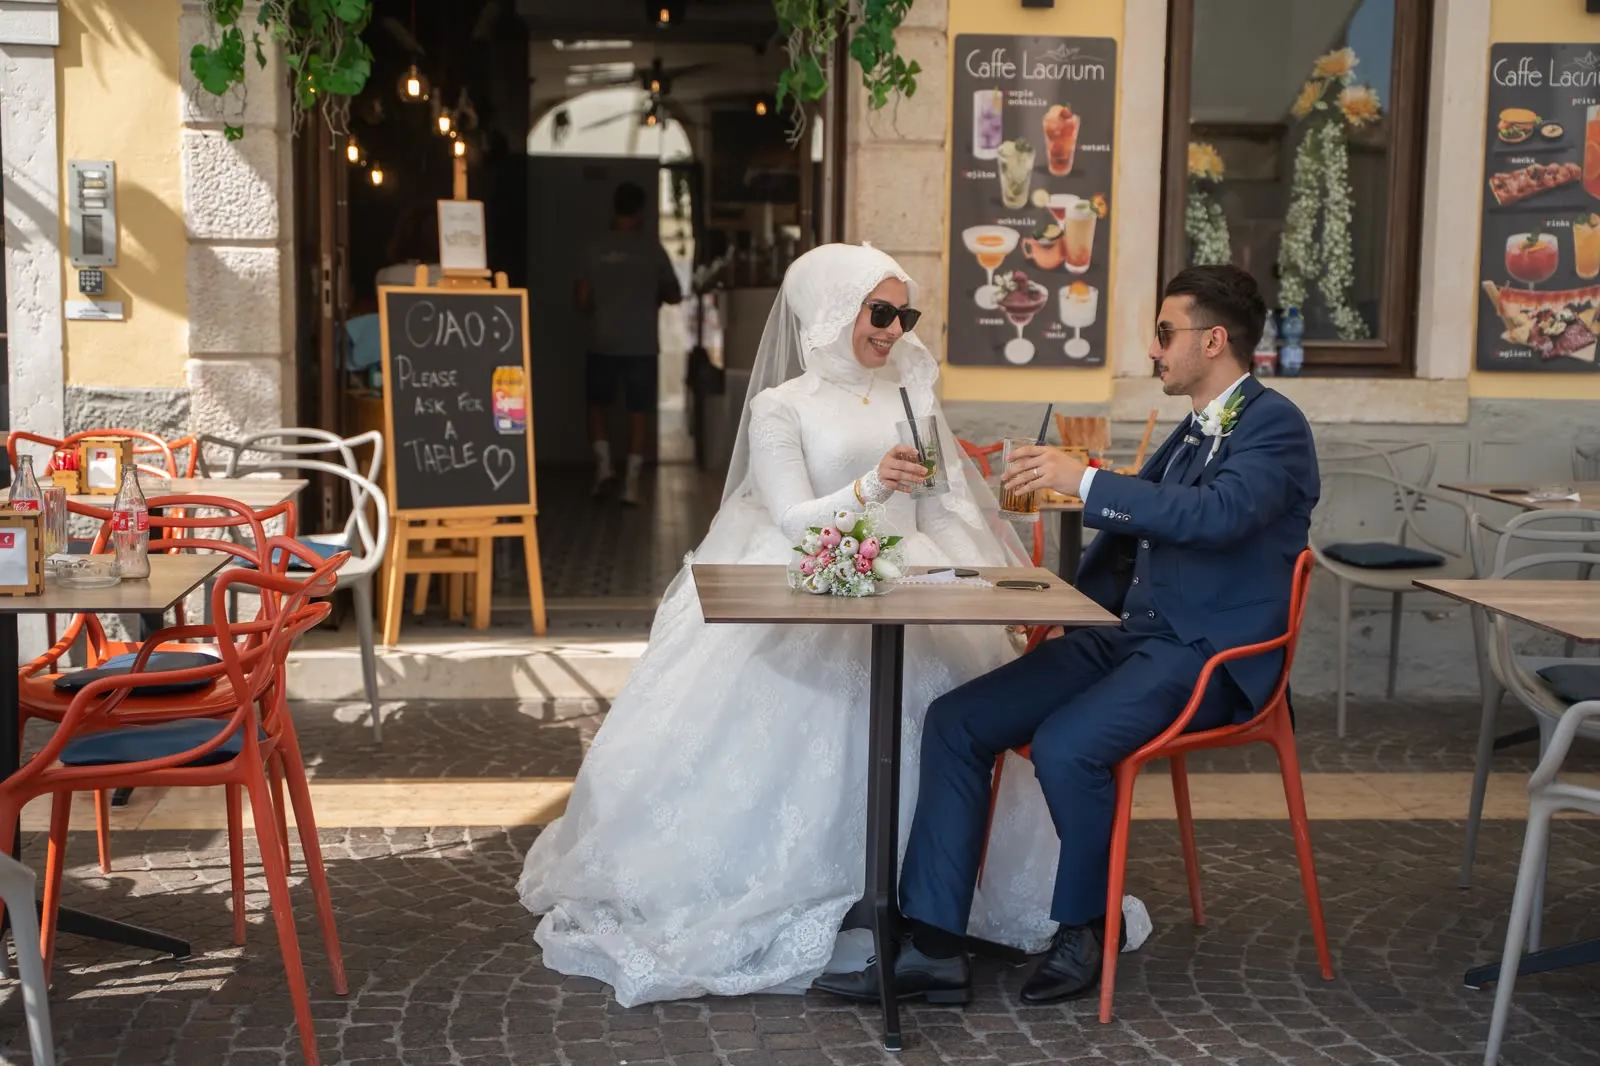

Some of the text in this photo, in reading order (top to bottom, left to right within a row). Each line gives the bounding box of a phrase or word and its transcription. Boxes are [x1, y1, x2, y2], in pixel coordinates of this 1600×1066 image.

[965, 47, 1016, 79] Caffe
[1493, 56, 1543, 87] Caffe
[1003, 98, 1048, 106] ocktails
[1541, 218, 1570, 228] rinks
[444, 419, 458, 440] A
